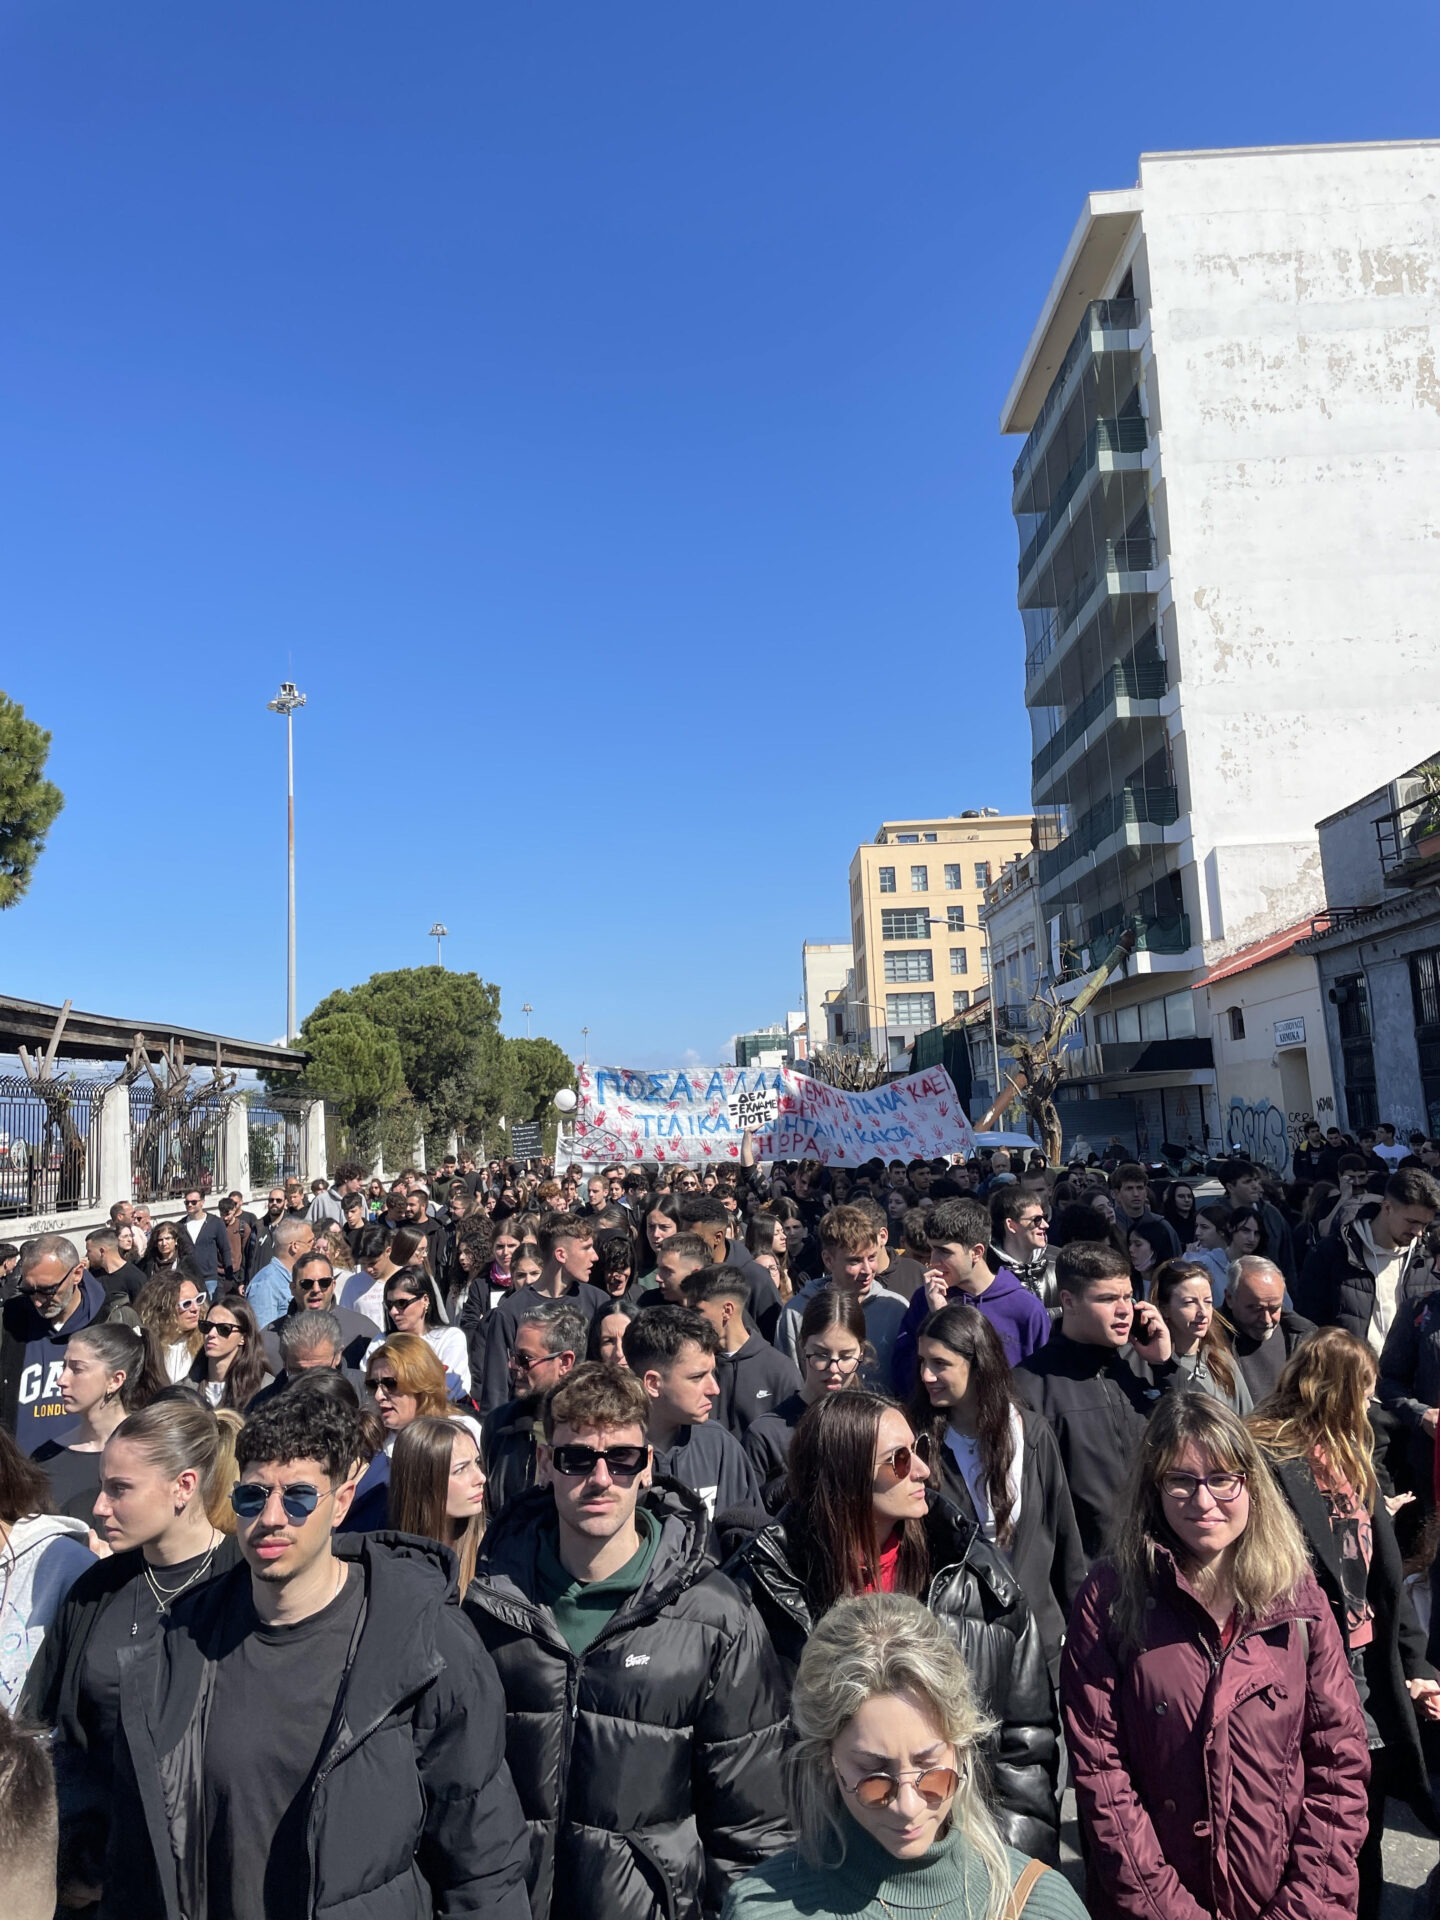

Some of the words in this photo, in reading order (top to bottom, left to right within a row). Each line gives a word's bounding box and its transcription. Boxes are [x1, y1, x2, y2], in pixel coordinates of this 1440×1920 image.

[594, 1071, 693, 1105] ΠΟΣΑ
[738, 1090, 767, 1104] ΔΕΝ
[728, 1099, 778, 1116] ΞΕΧΝΑΜΕ
[635, 1112, 731, 1139] ΤΕΛΙΚΑ
[738, 1110, 772, 1128] ΠΟΤΕ
[19, 1361, 64, 1404] GA
[34, 1403, 67, 1418] LOND
